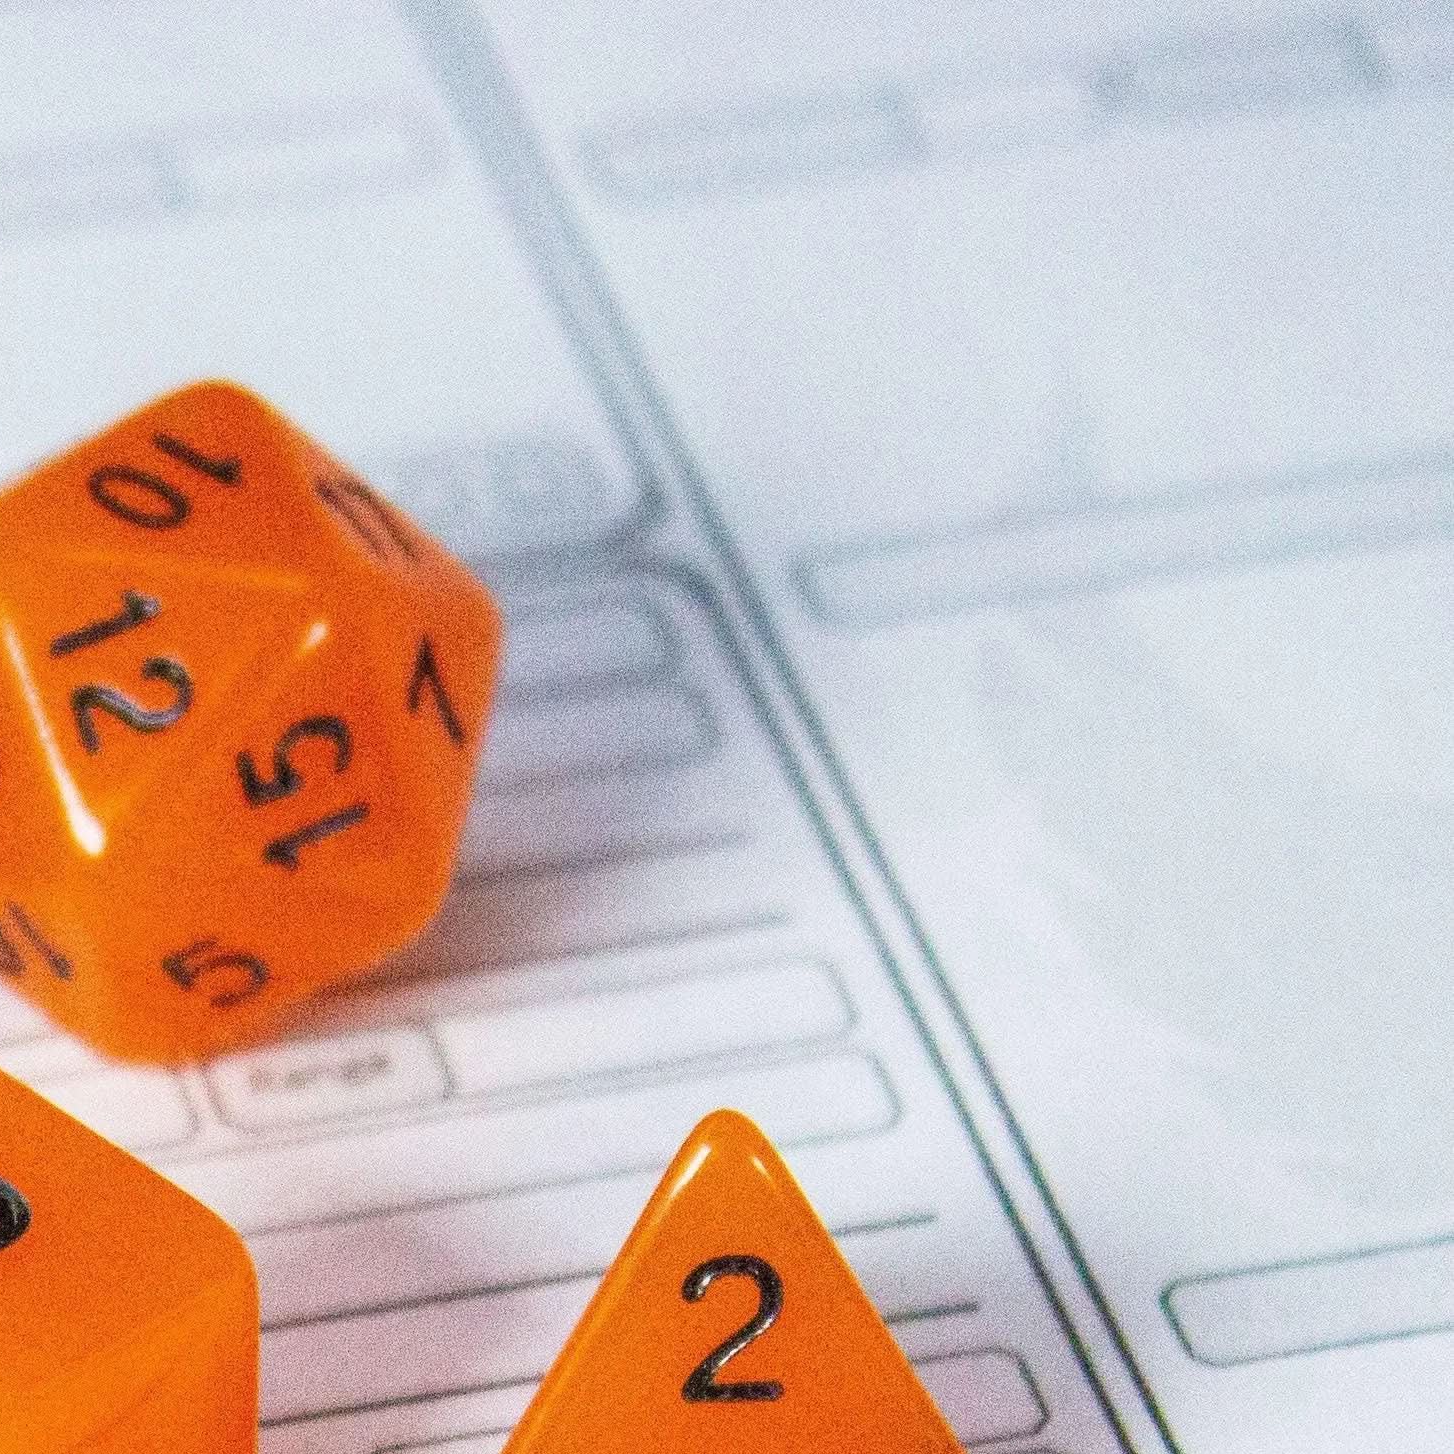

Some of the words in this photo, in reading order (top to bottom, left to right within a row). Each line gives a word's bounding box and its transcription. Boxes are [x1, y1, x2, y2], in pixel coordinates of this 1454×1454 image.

[87, 432, 243, 532] 10
[49, 589, 194, 754] 12
[235, 713, 371, 872] 15
[680, 1253, 785, 1404] 2
